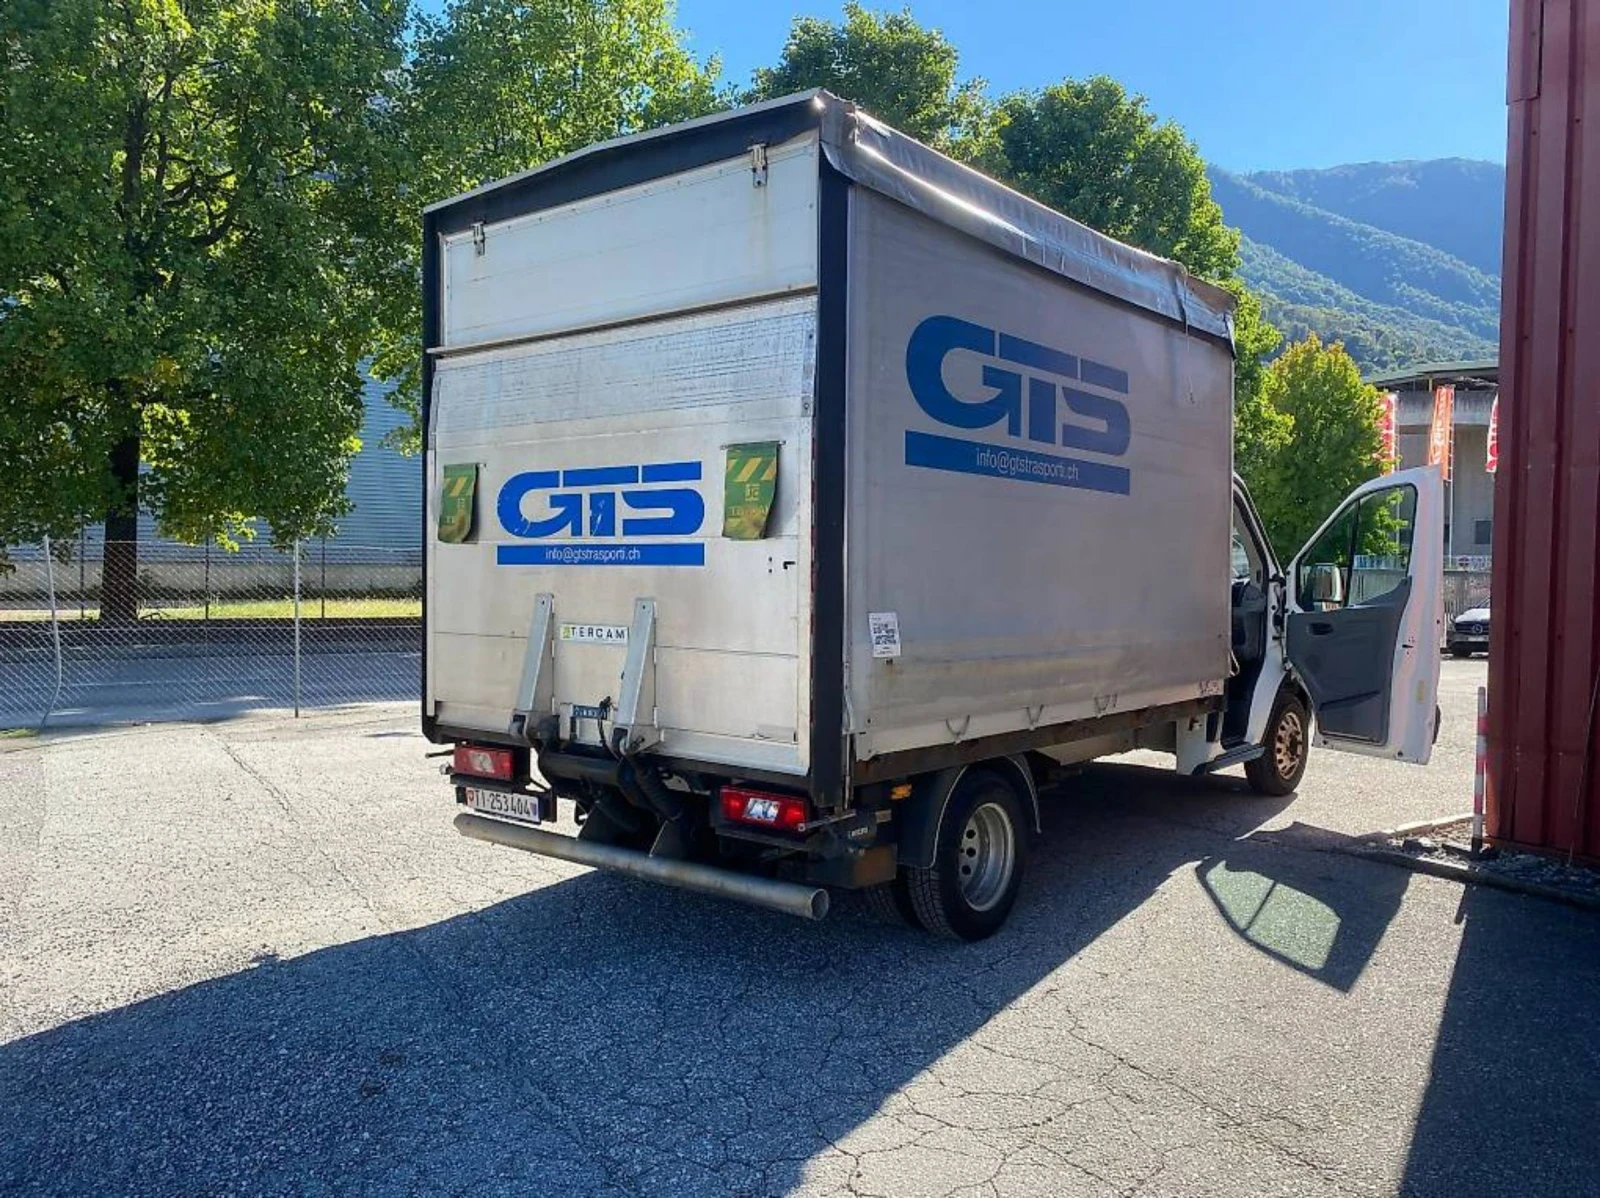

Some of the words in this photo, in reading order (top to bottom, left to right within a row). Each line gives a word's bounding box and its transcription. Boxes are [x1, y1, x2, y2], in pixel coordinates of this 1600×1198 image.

[906, 314, 1131, 457] GTS
[976, 447, 1079, 480] info@gtstrasporti.ch
[497, 461, 705, 538] GTS
[545, 547, 641, 563] info@gtstrasporti.ch
[571, 626, 625, 639] TERCAM
